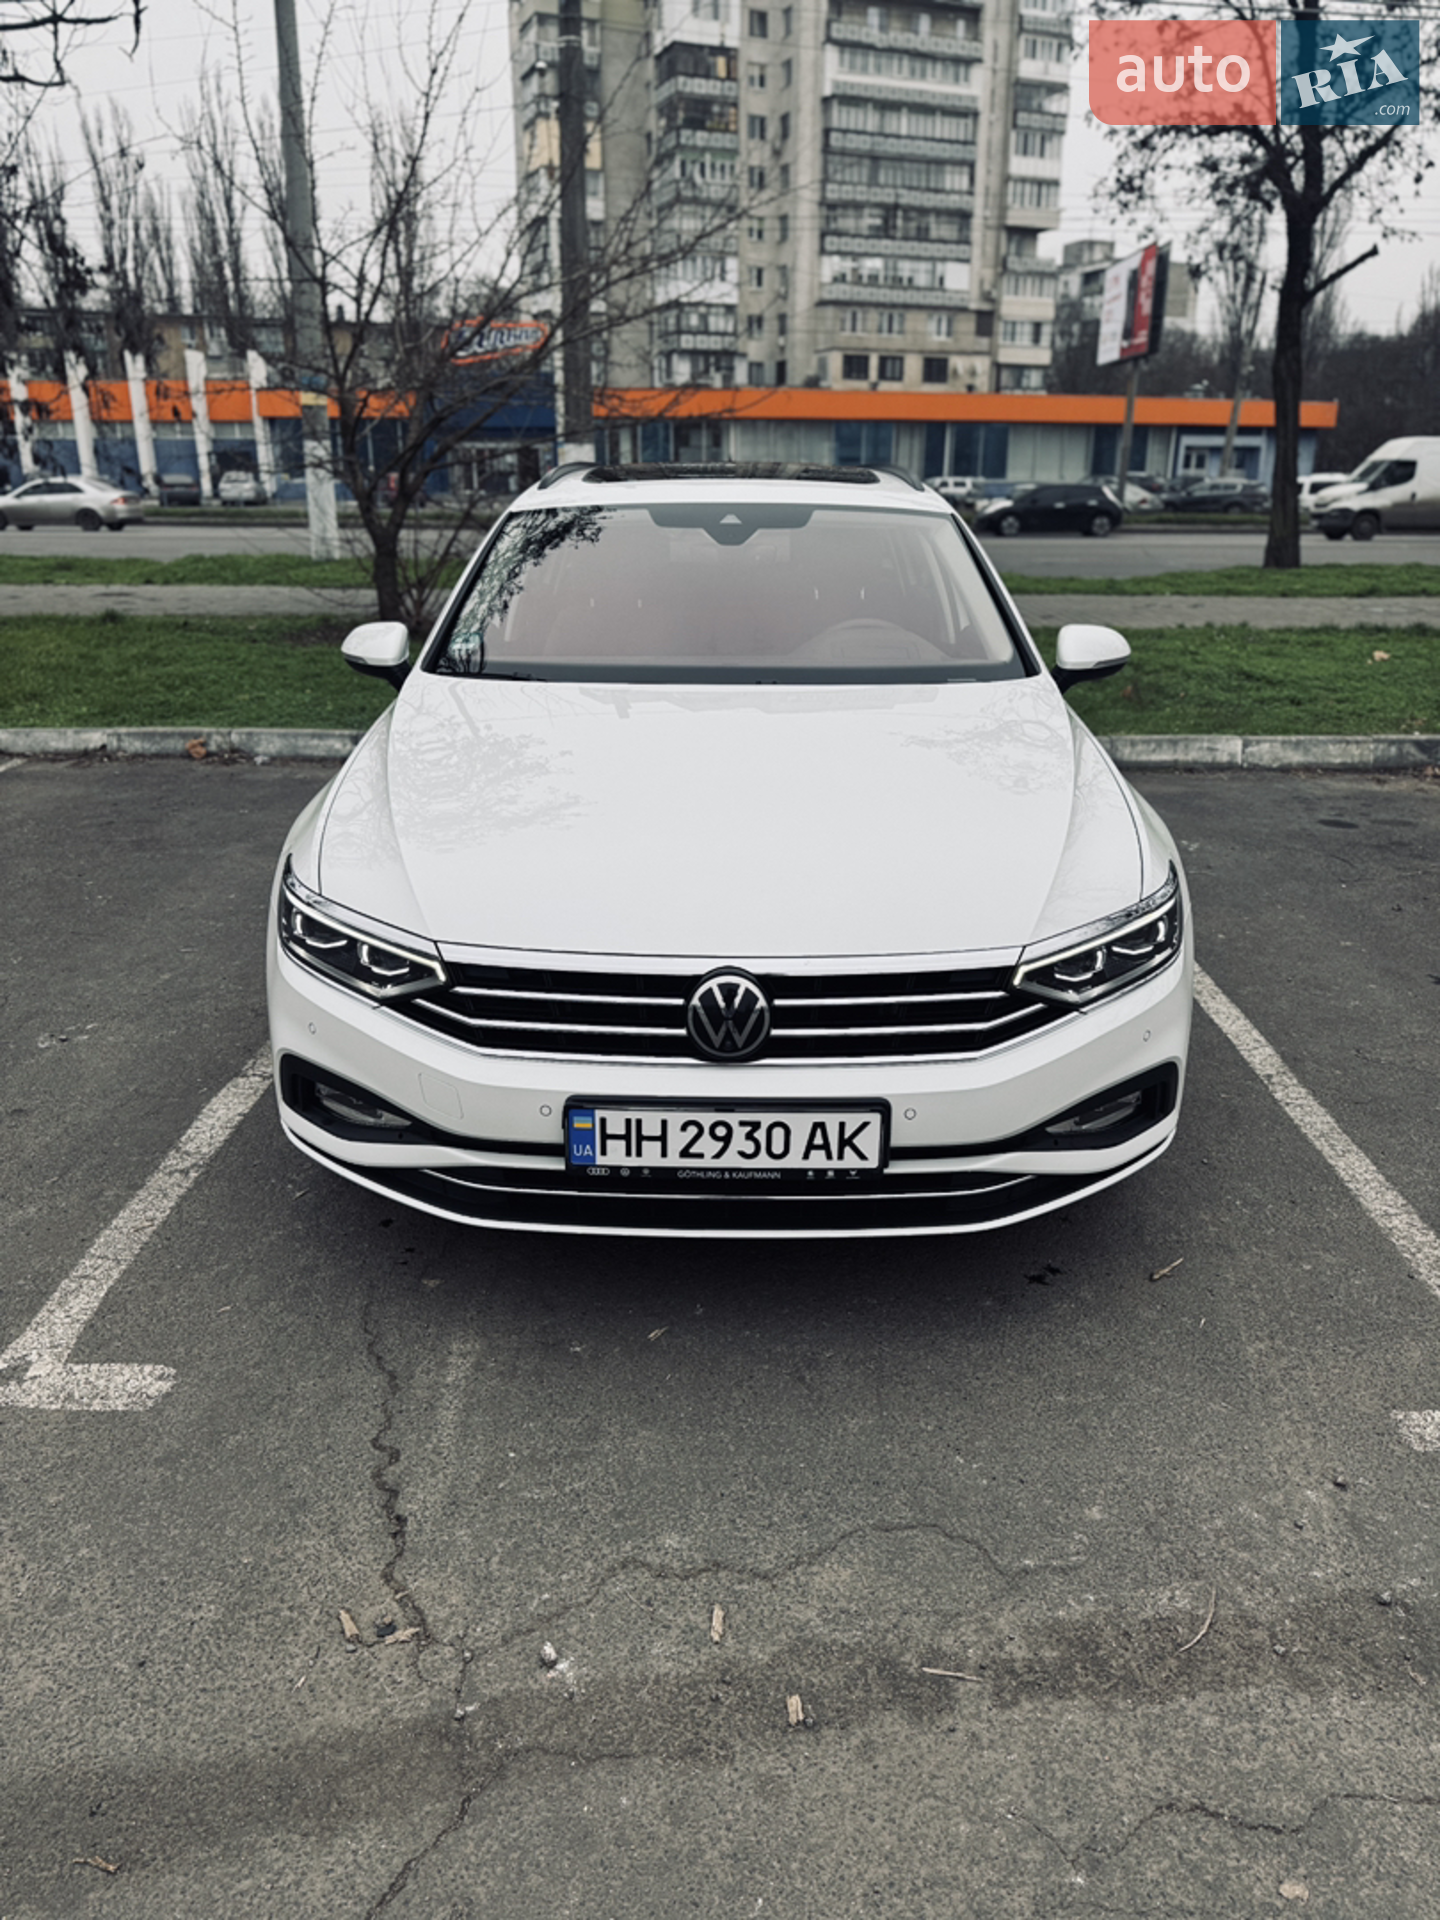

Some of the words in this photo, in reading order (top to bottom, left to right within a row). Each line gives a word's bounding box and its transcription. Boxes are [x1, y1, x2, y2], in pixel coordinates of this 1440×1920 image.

[573, 1144, 593, 1157] UA
[600, 1117, 668, 1159] HH
[679, 1119, 792, 1161] 2930
[801, 1121, 872, 1162] AK
[677, 1169, 723, 1180] GÖTHLING
[724, 1171, 731, 1179] &
[732, 1171, 781, 1180] KAUFMANN
